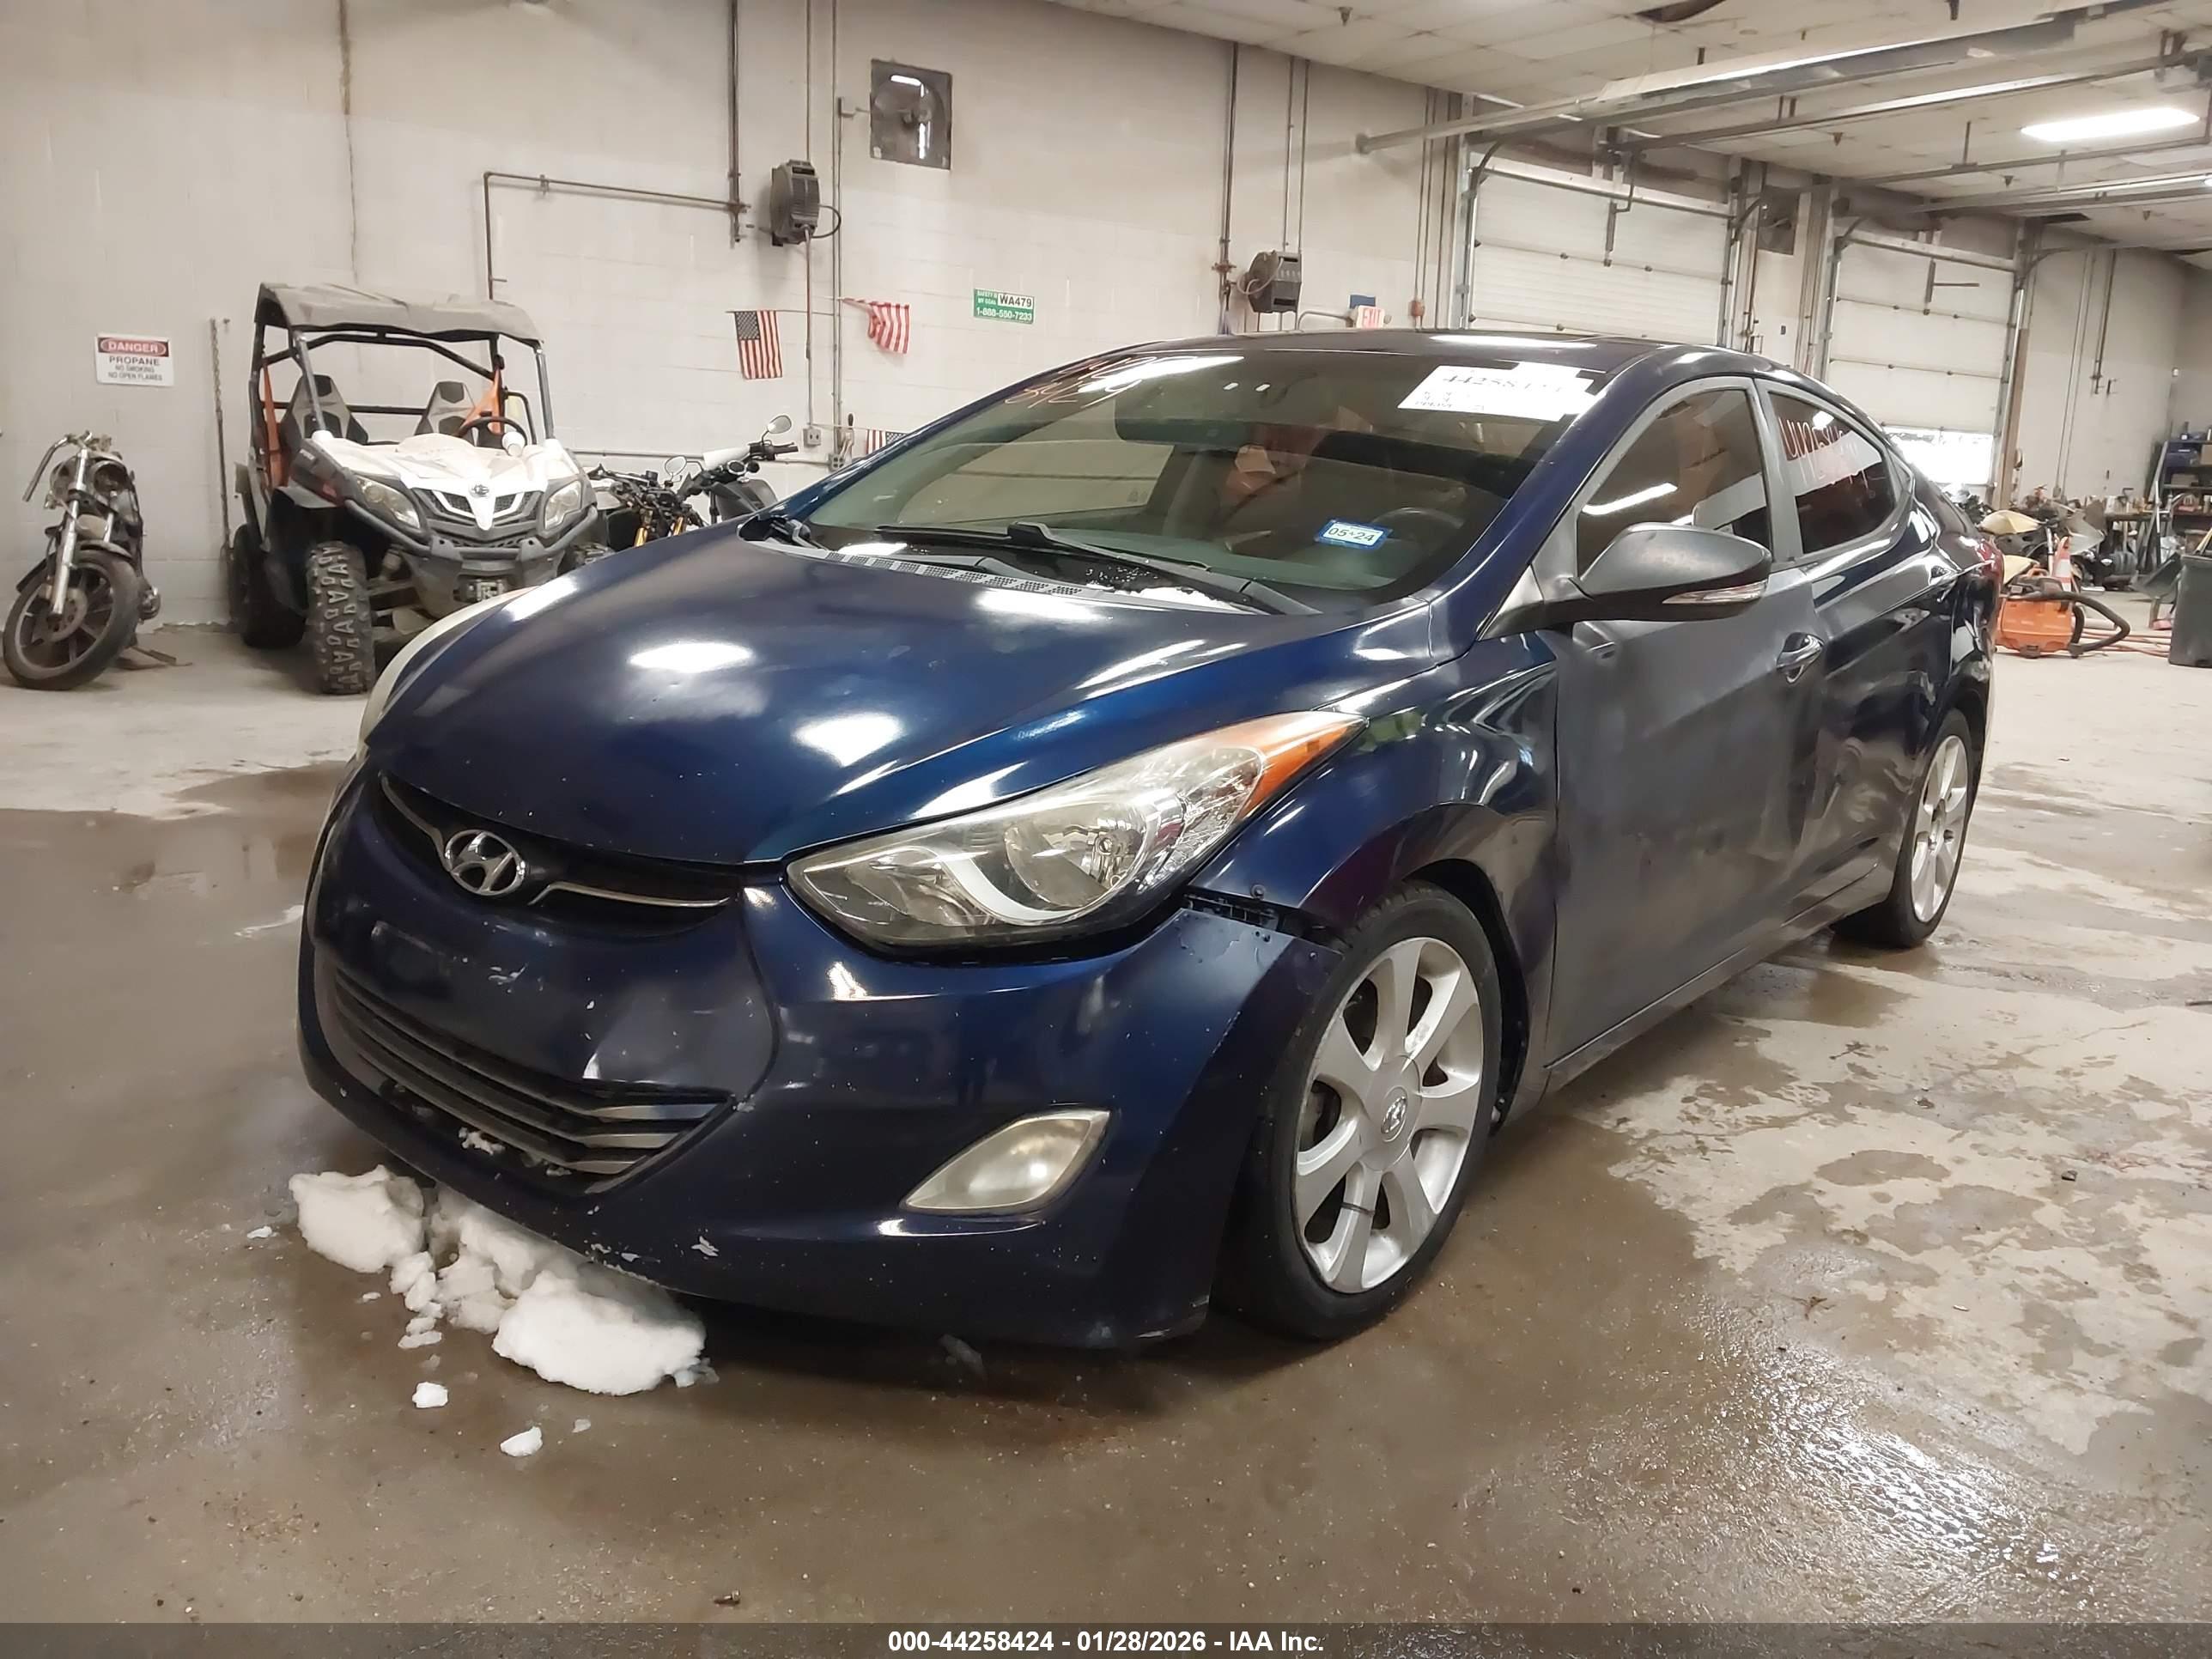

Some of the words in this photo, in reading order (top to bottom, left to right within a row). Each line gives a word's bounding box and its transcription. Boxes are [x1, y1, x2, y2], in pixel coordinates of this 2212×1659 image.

[1000, 294, 1032, 307] WA479
[107, 341, 159, 353] DANGER
[109, 356, 161, 366] PROPANE
